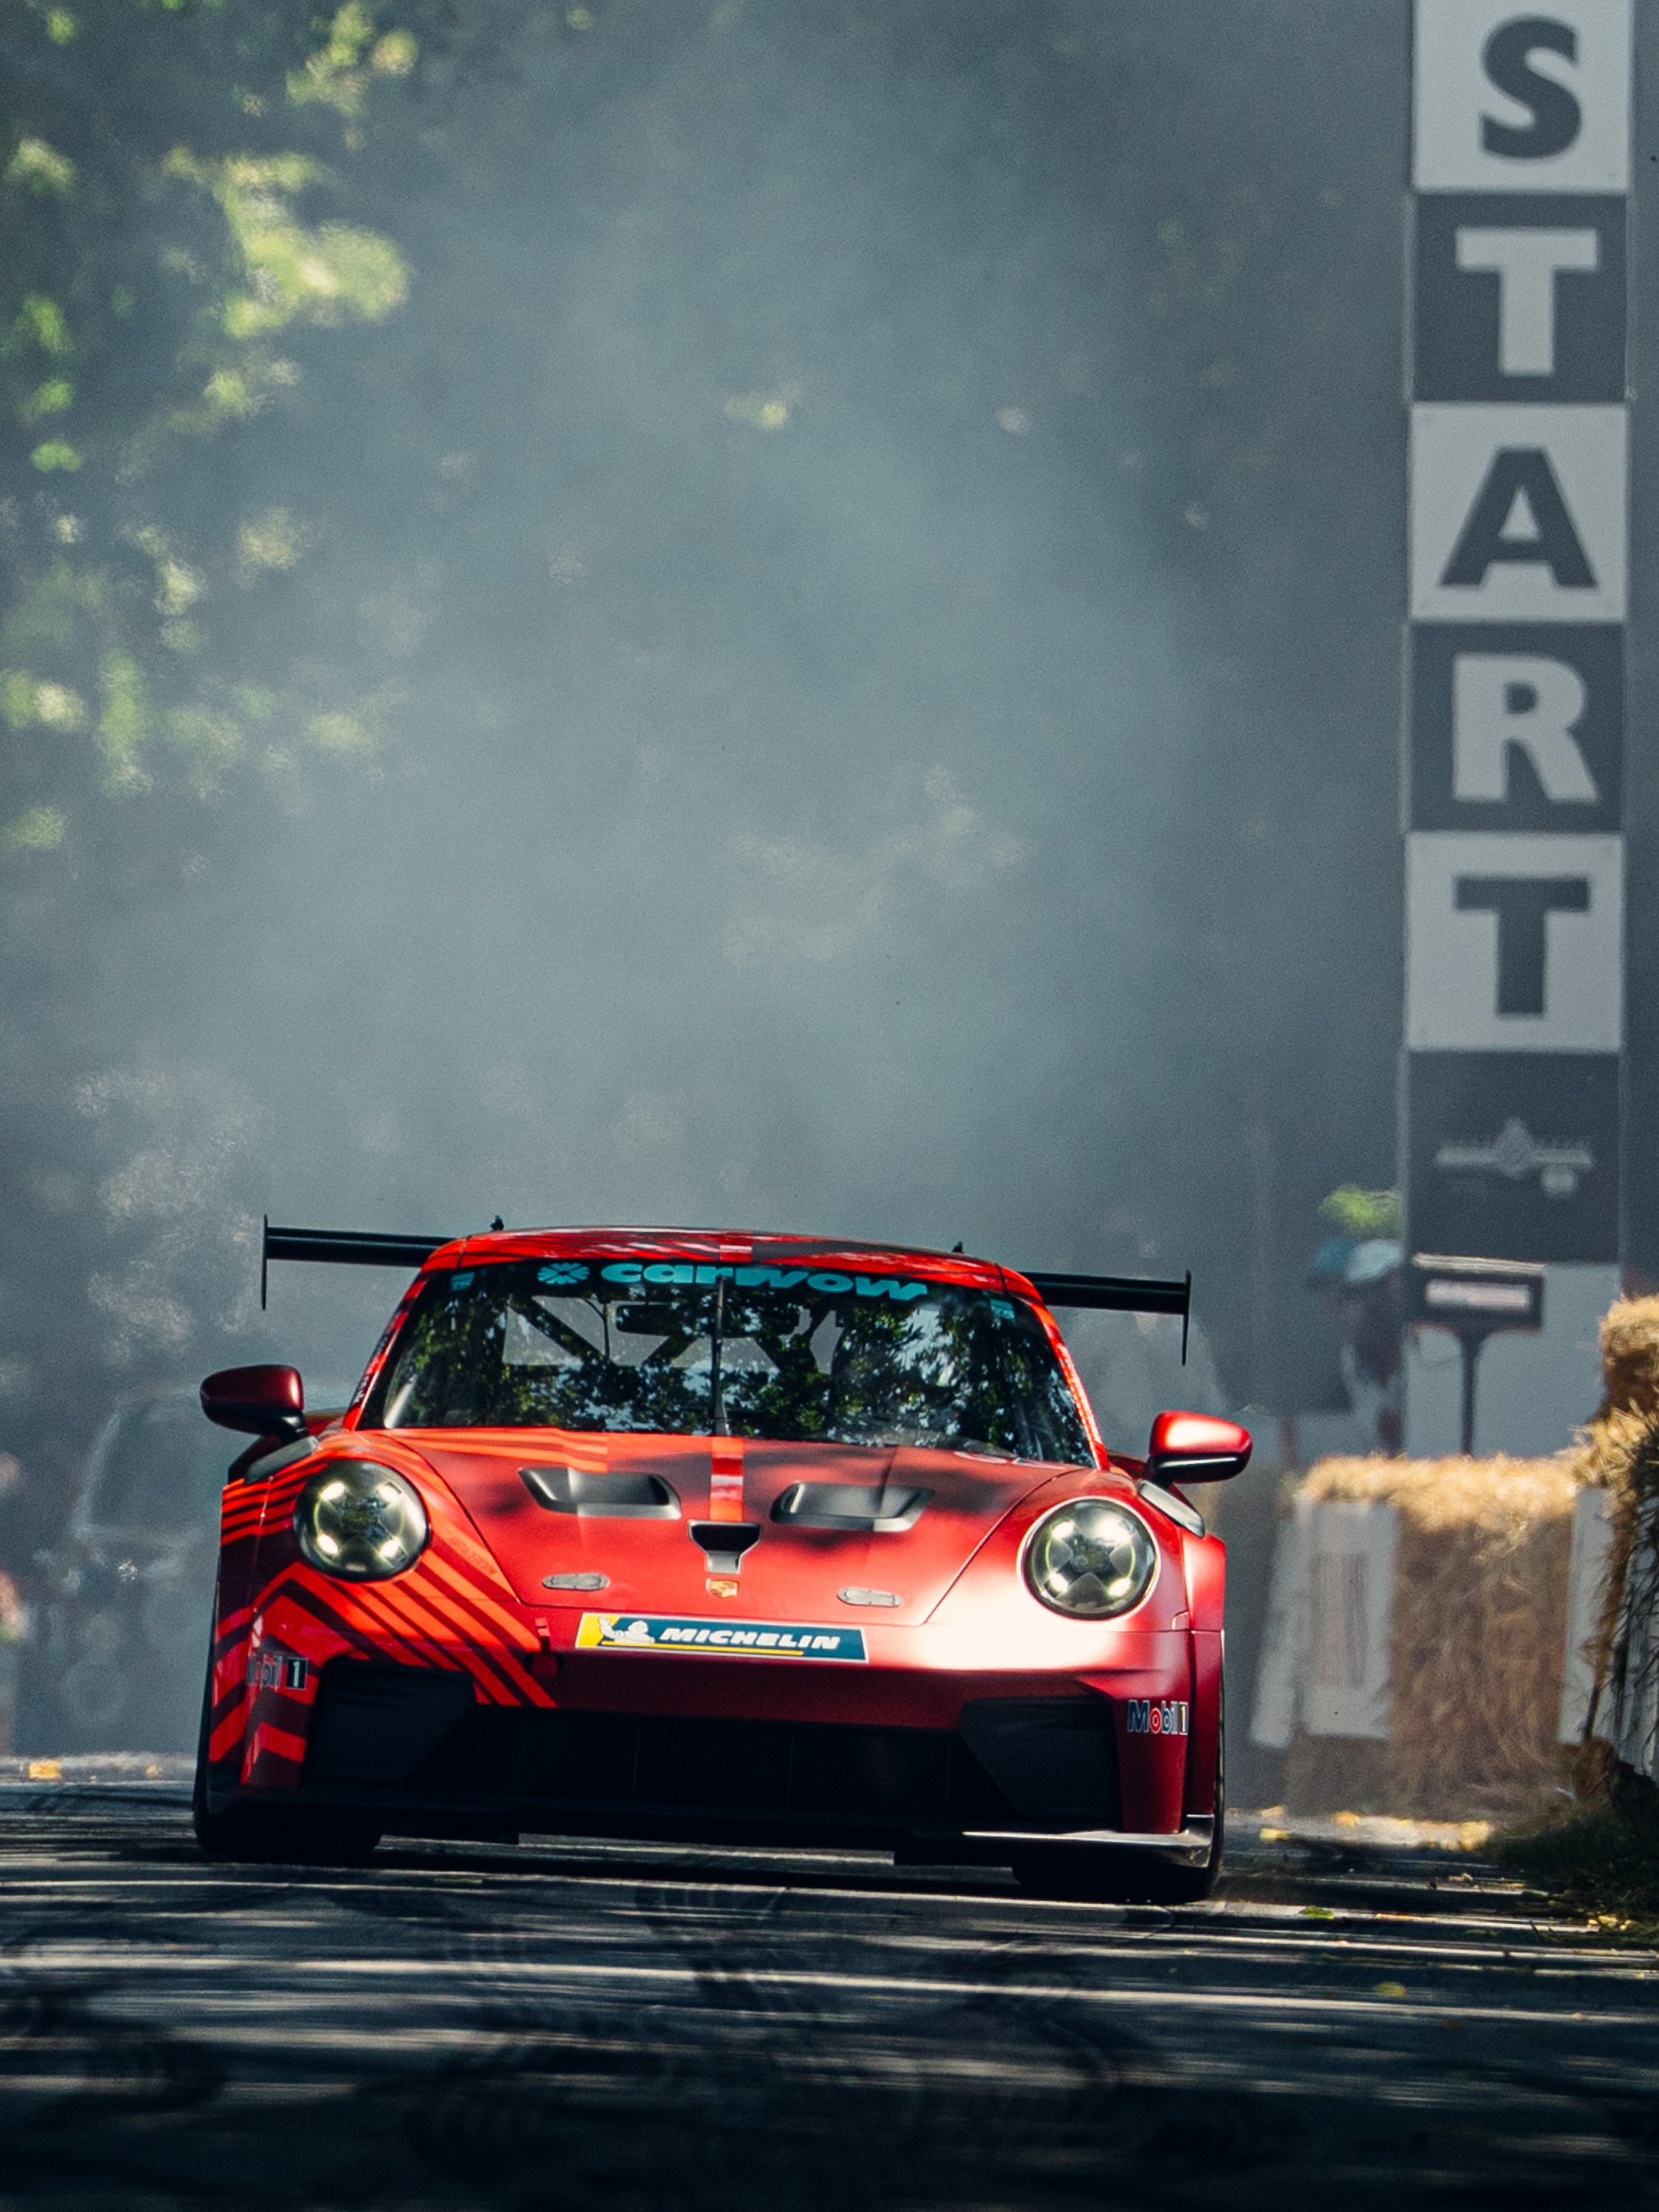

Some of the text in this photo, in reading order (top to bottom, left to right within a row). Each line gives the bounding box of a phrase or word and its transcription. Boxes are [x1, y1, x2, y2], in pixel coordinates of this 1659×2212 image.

[1439, 14, 1600, 1020] START
[601, 1263, 928, 1302] carwow
[659, 1626, 841, 1651] MICHELIN
